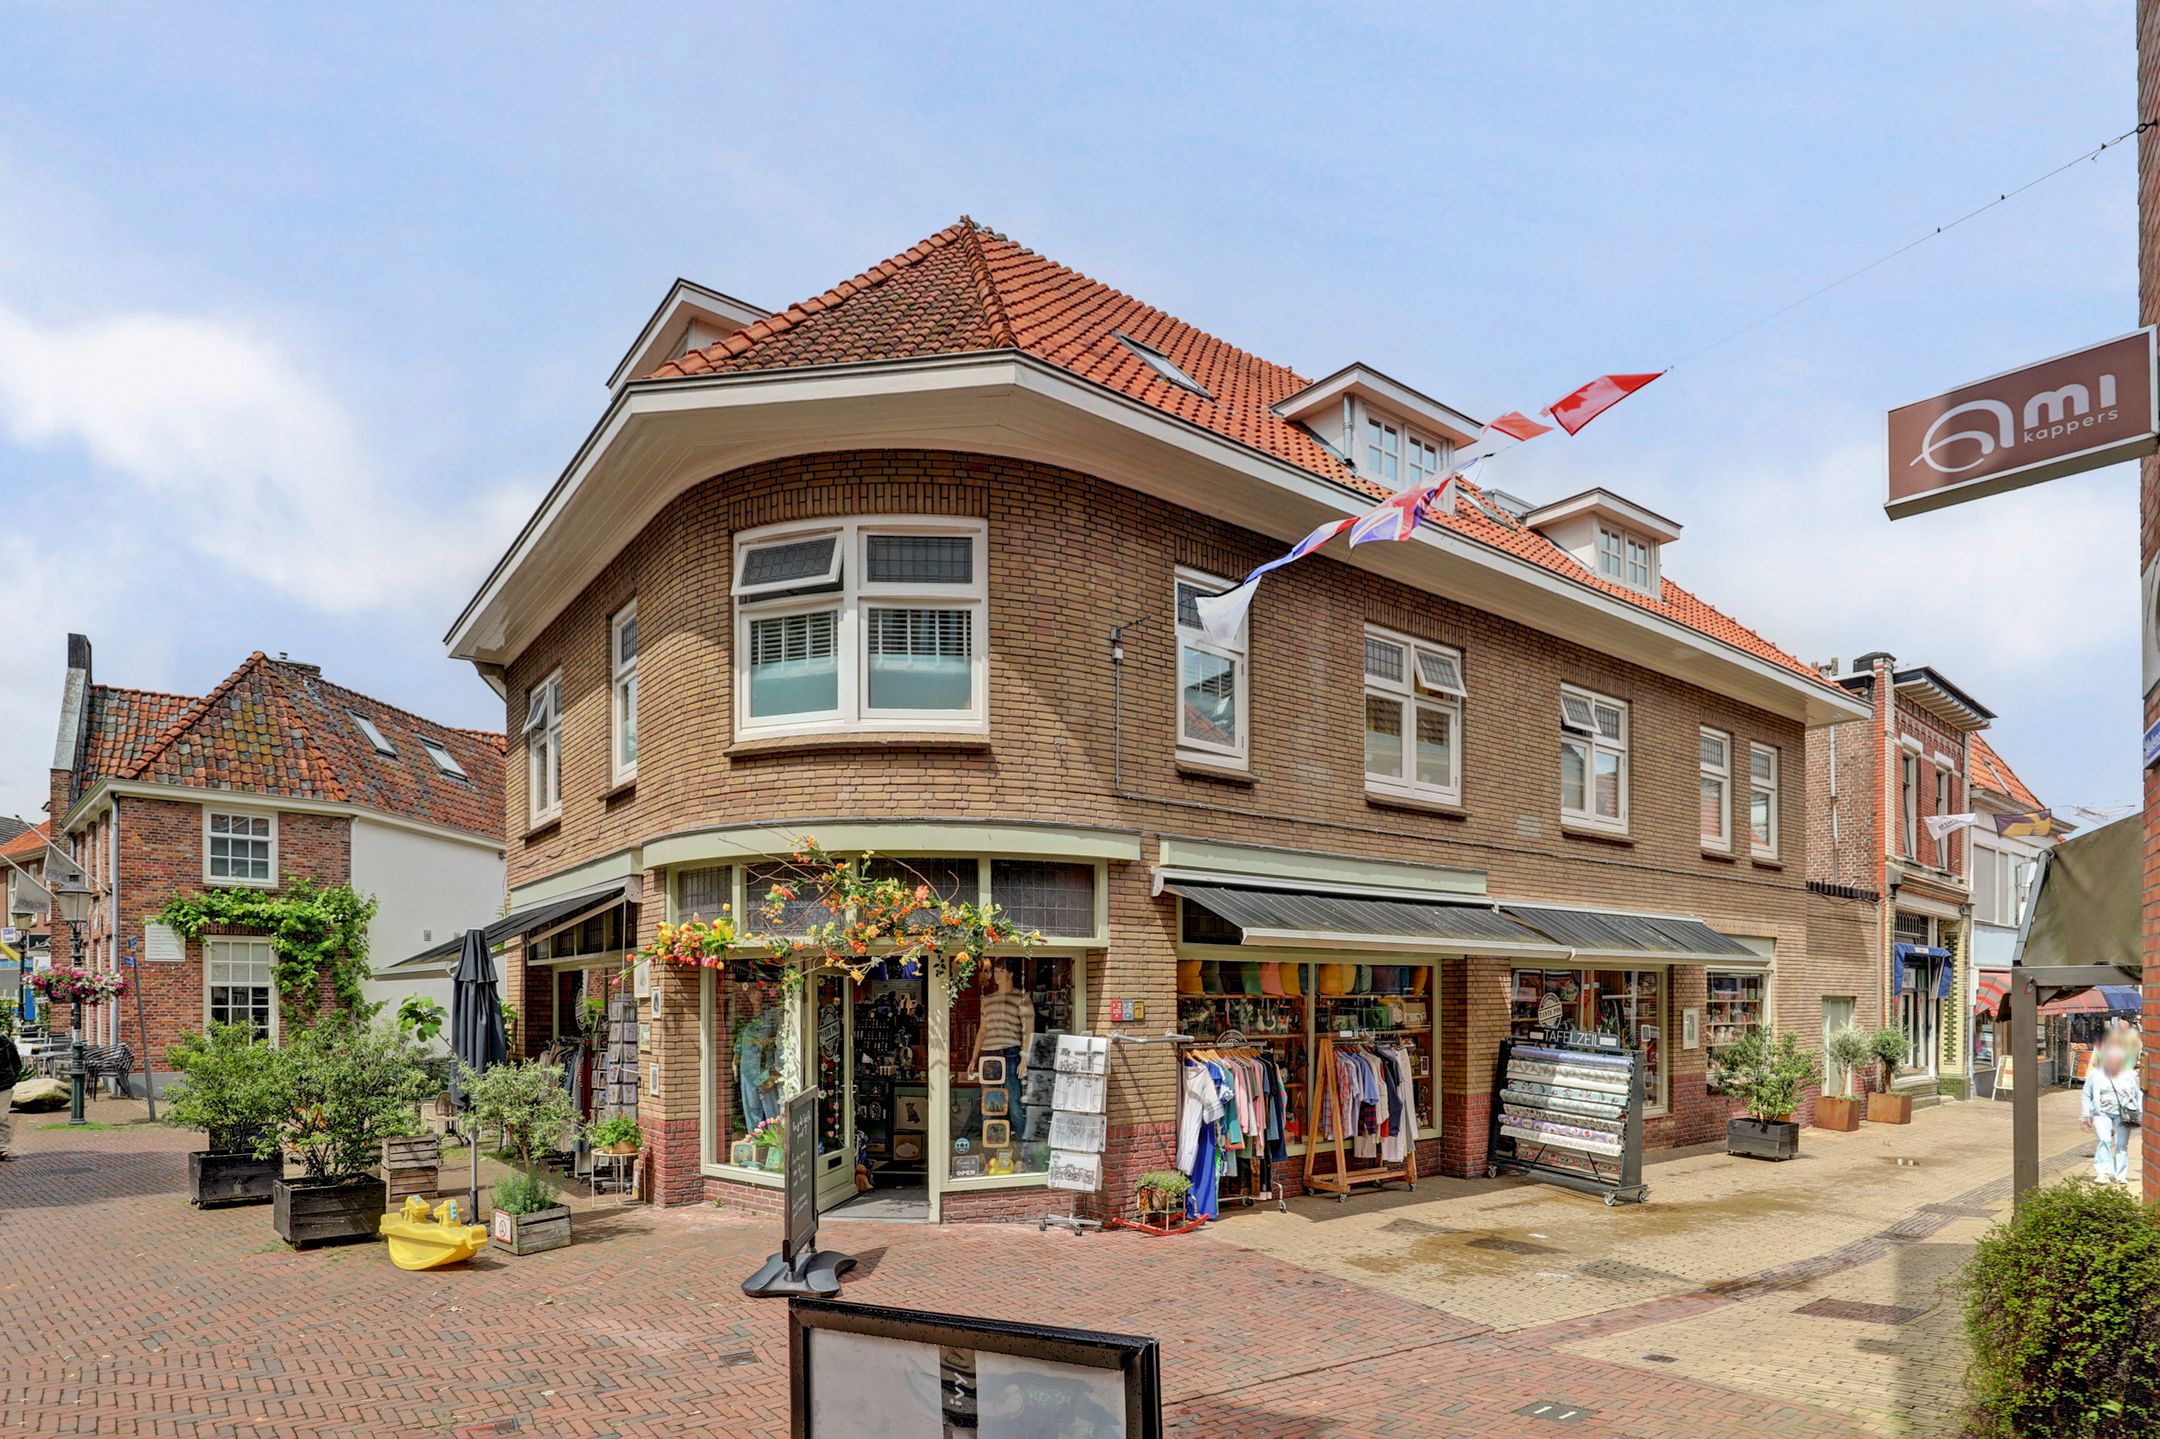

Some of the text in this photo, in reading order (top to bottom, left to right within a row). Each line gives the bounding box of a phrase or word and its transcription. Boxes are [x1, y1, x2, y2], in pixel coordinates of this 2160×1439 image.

[2023, 409, 2119, 444] kappers
[1544, 1029, 1601, 1047] TAFELZEIL
[956, 1169, 976, 1177] OPEN
